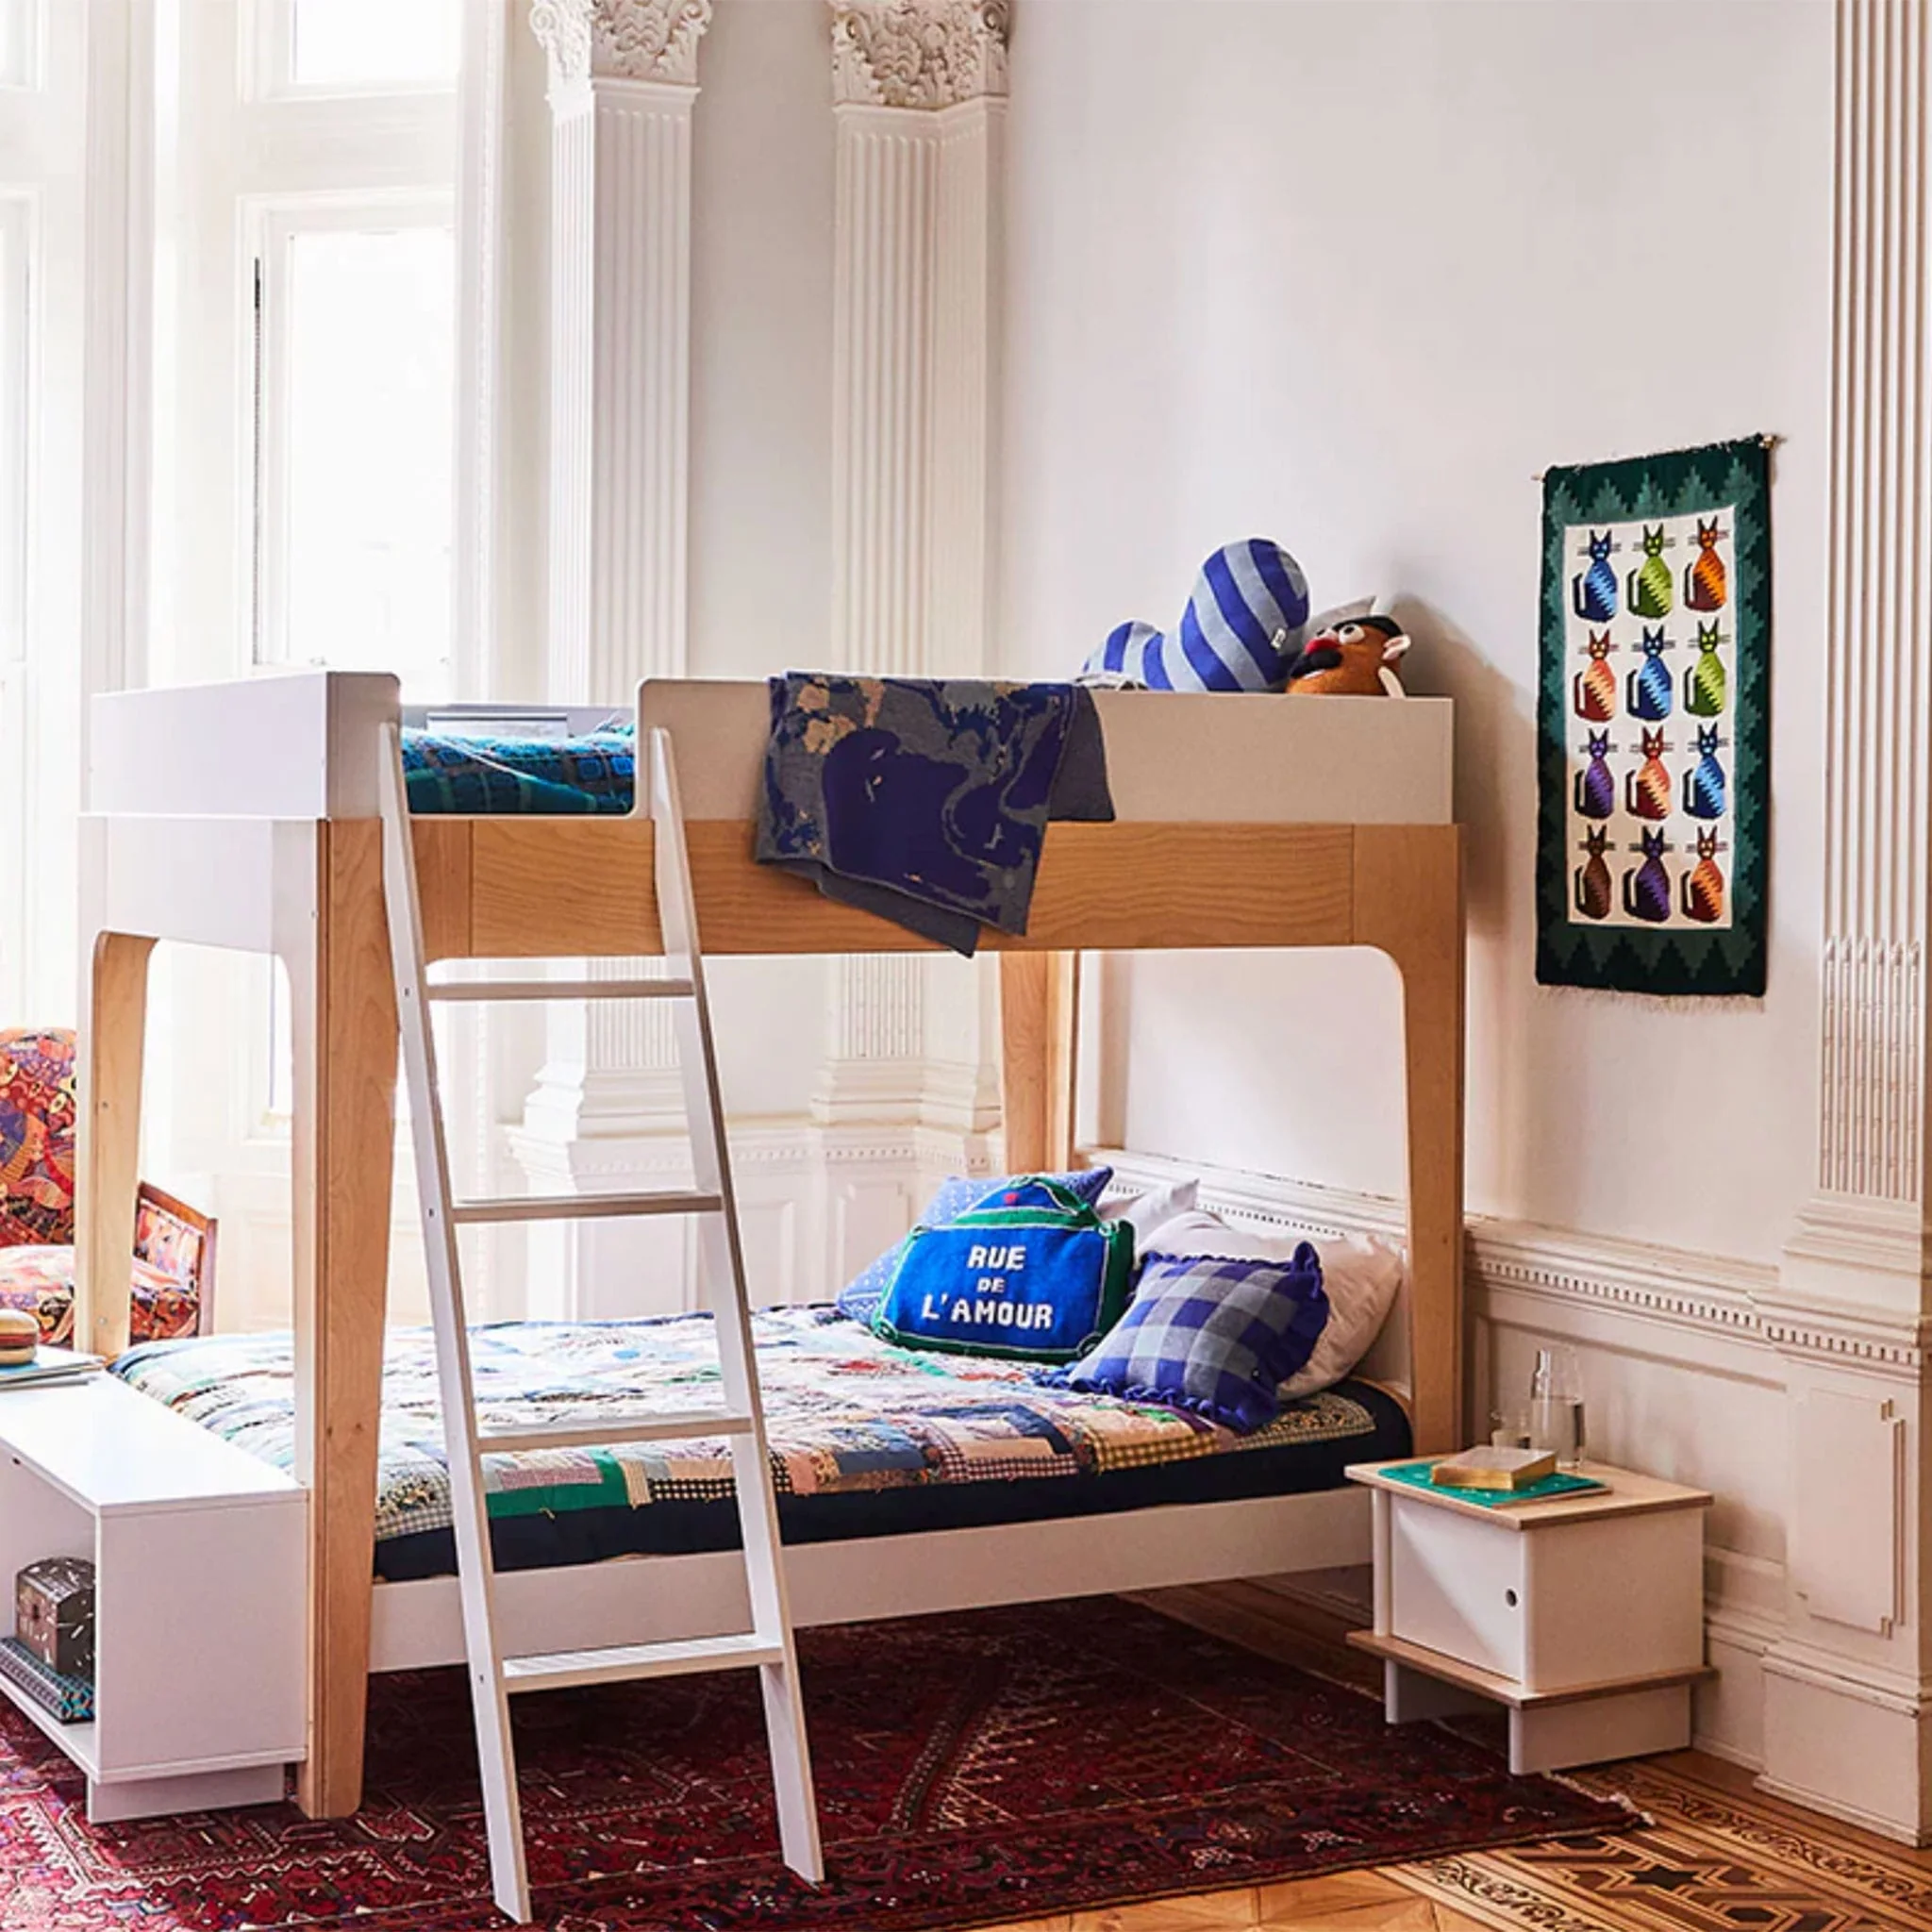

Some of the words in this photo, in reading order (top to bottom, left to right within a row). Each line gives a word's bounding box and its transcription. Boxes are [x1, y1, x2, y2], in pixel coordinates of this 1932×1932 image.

[967, 1244, 1026, 1271] RUE
[976, 1277, 1005, 1293] DE
[922, 1293, 1053, 1329] L'AMOUR
